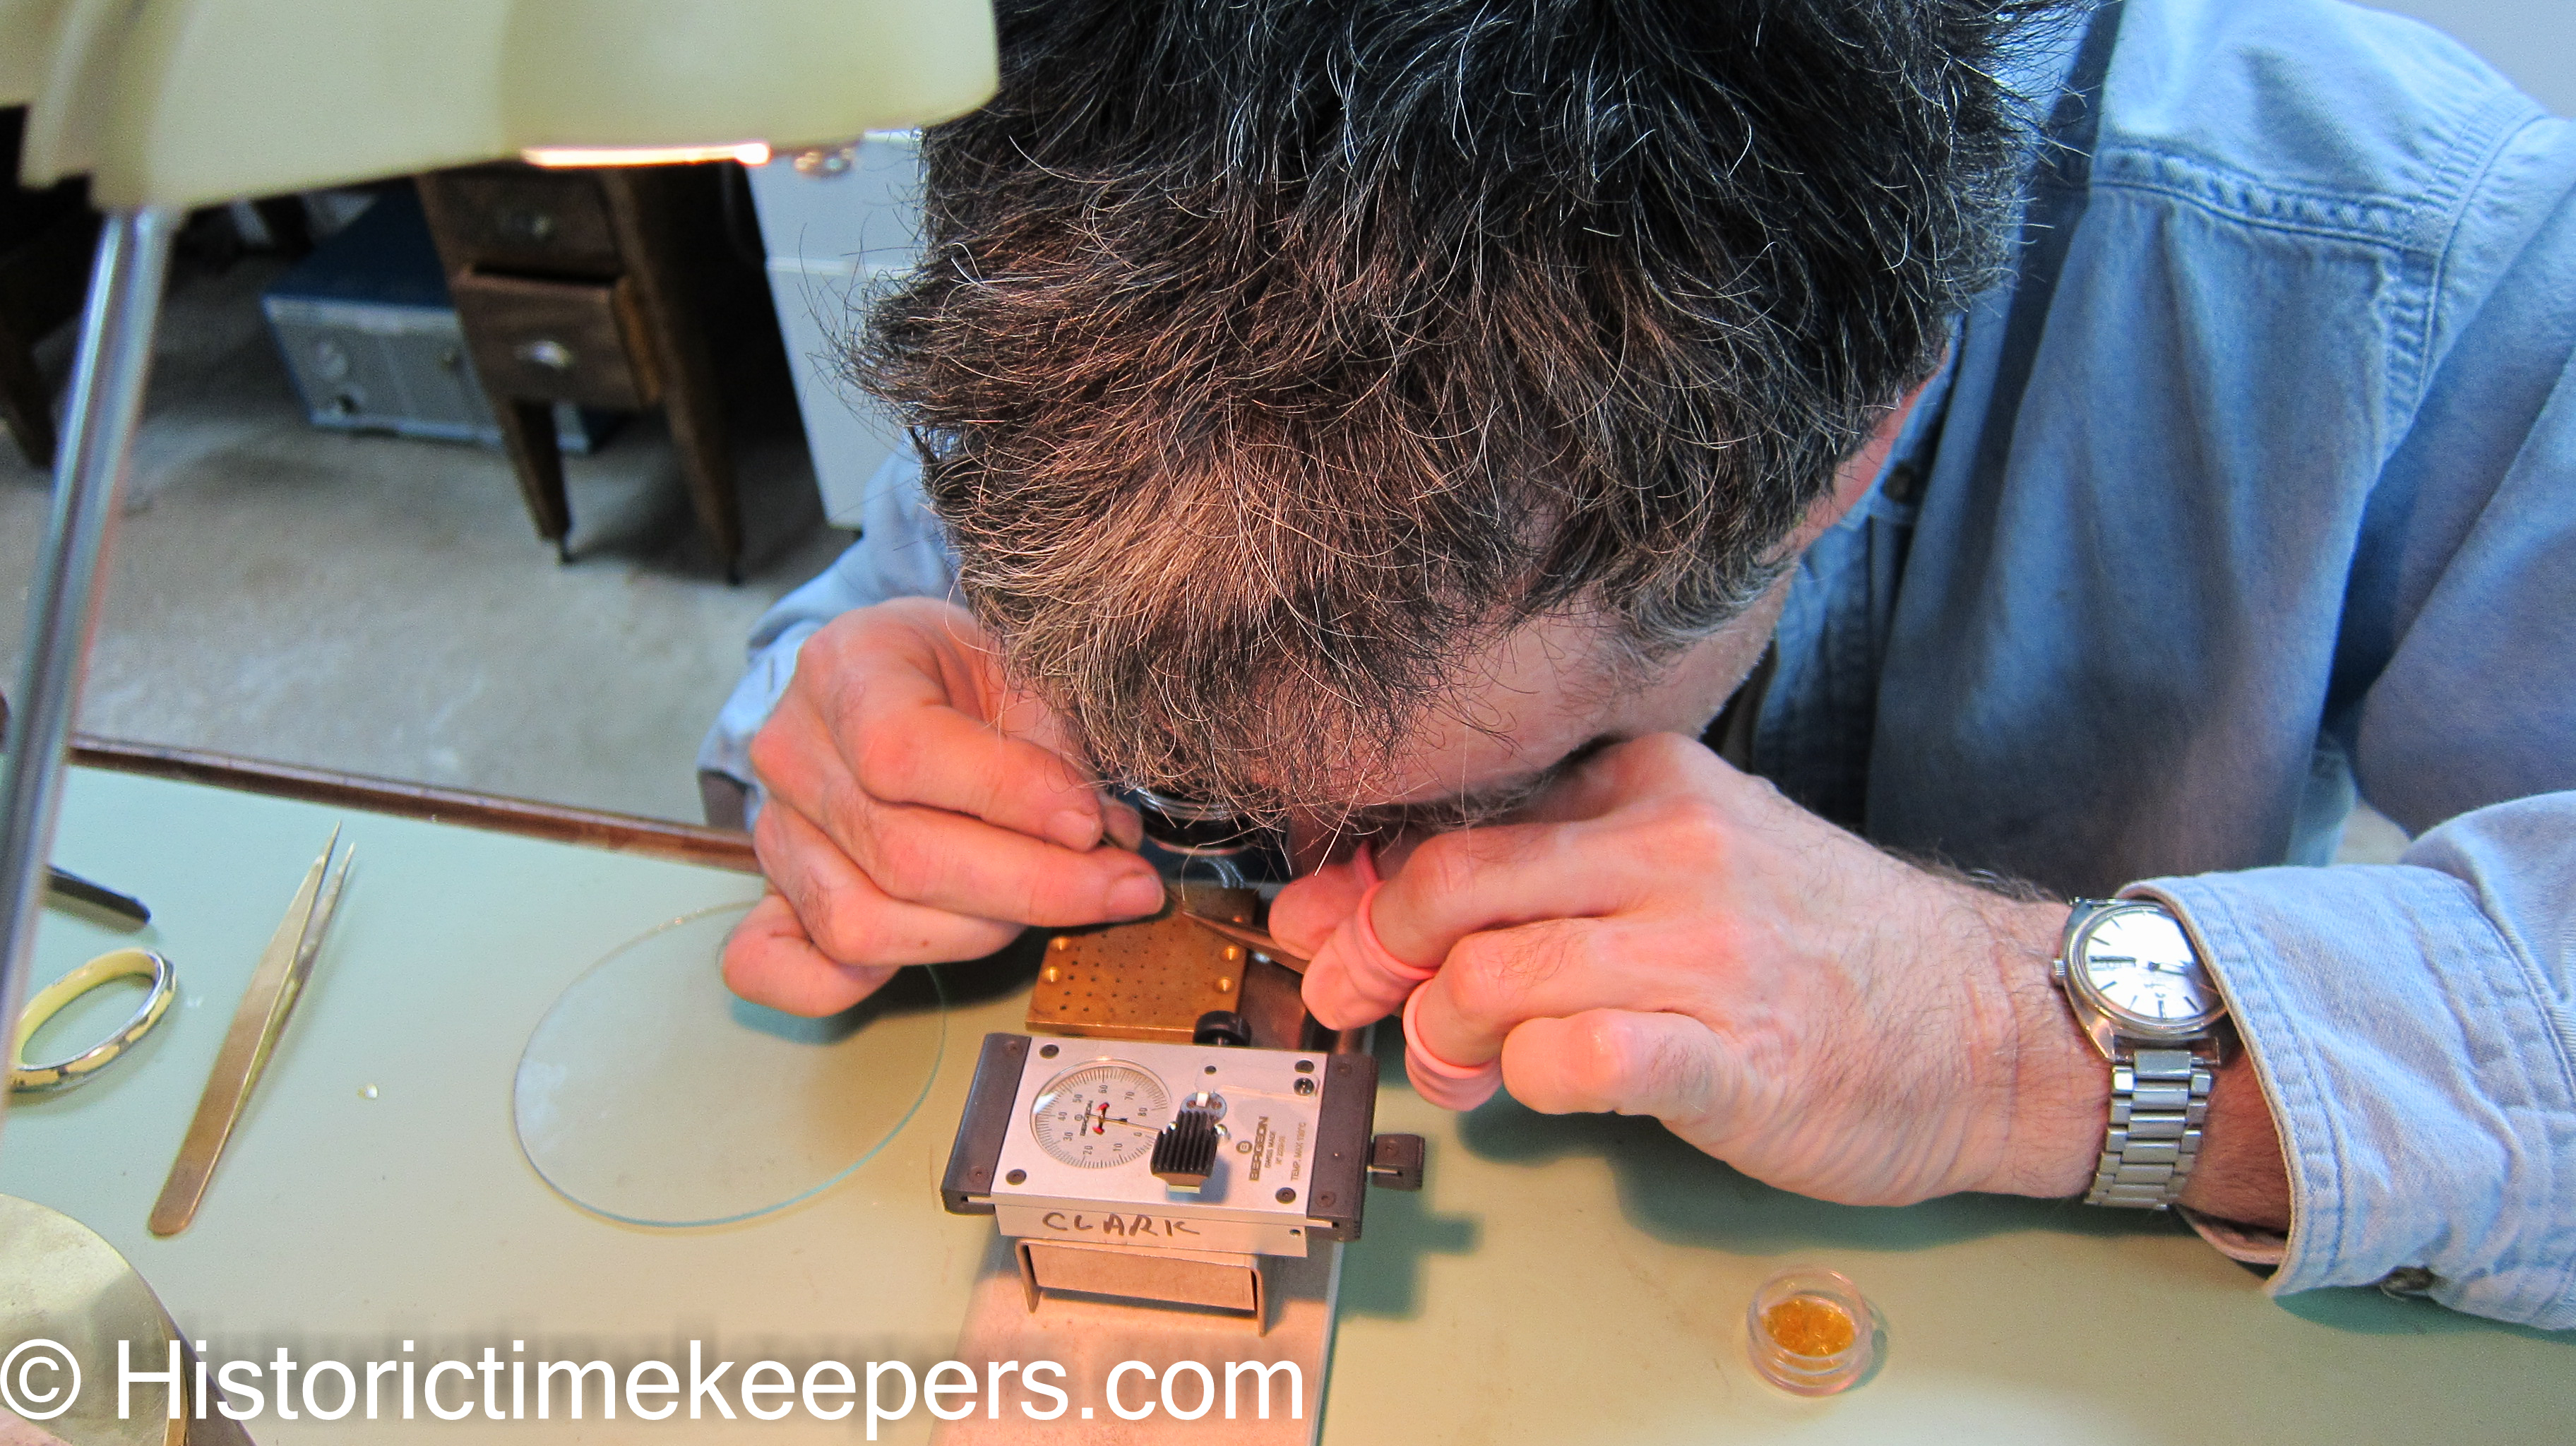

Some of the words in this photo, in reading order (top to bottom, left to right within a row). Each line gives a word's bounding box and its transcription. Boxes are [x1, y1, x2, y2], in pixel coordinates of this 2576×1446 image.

[1098, 1084, 1108, 1094] 60
[1073, 1094, 1083, 1103] 50
[1124, 1092, 1135, 1101] 70
[1058, 1111, 1068, 1121] 40
[1138, 1107, 1147, 1117] 80
[1063, 1132, 1074, 1141] 30
[1083, 1145, 1093, 1155] 20
[1113, 1142, 1123, 1152] 10
[1248, 1116, 1268, 1181] BERGEON
[1042, 1212, 1200, 1236] CLARK
